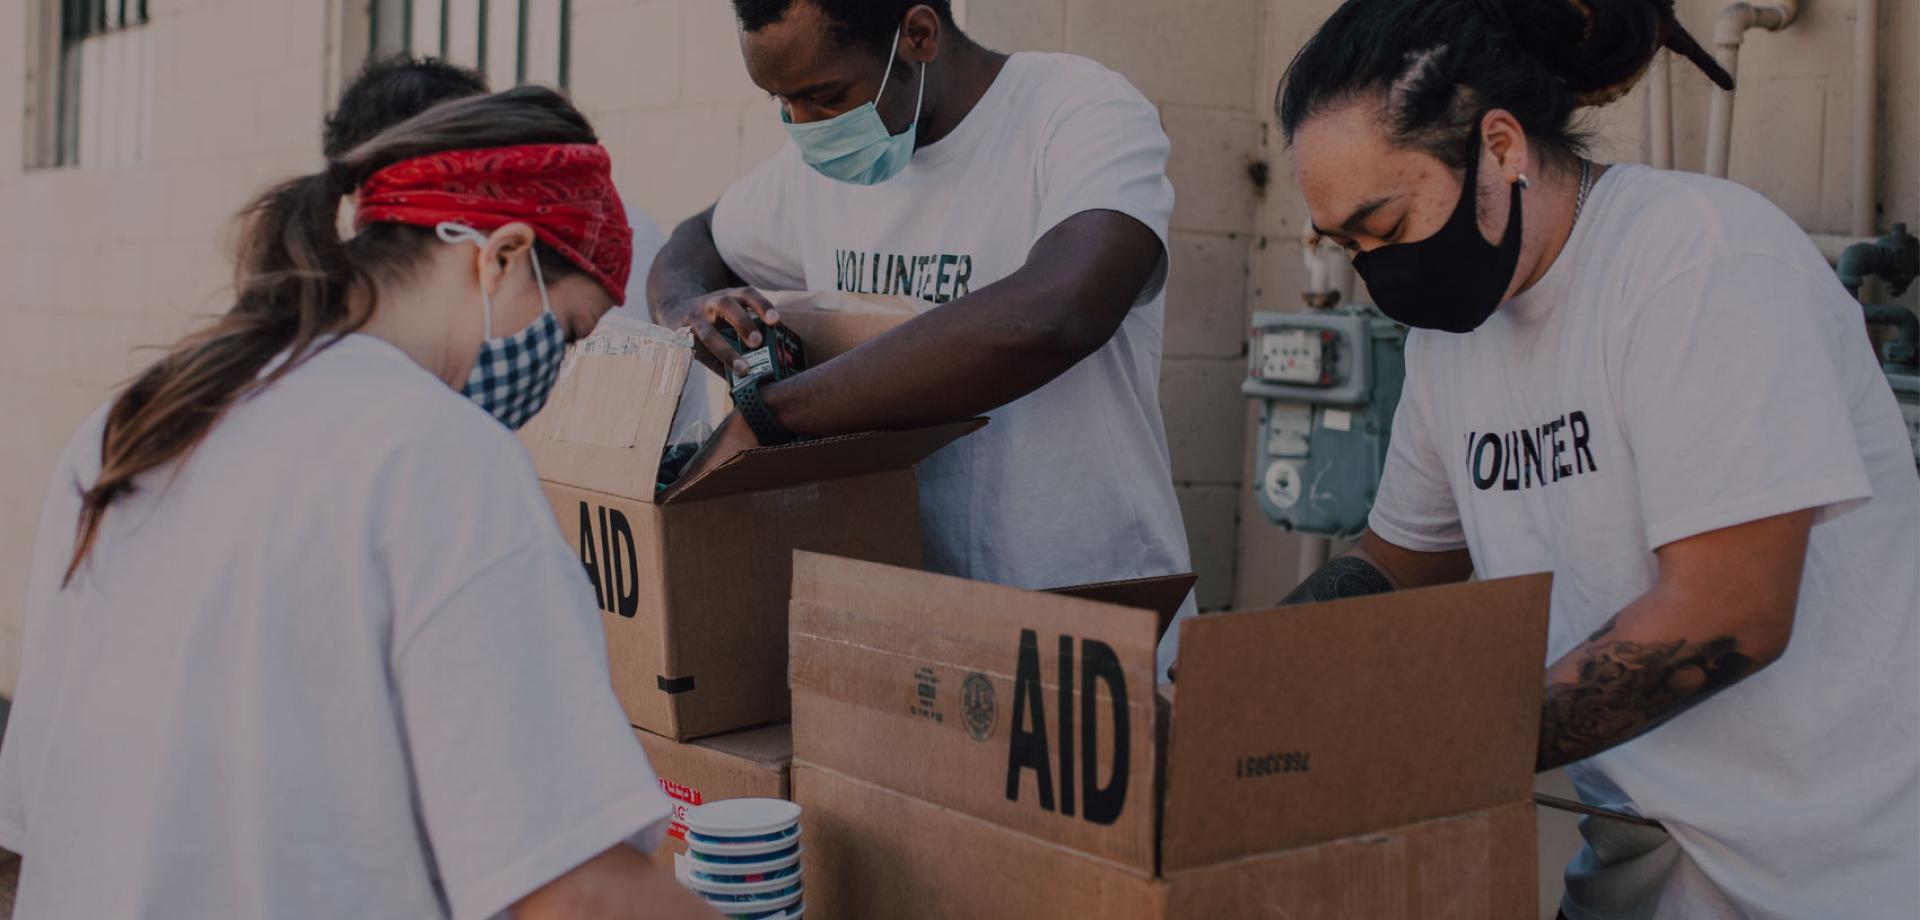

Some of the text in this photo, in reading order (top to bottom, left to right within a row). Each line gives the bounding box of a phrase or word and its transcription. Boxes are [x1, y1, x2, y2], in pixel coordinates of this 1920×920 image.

[836, 249, 973, 303] VOLUNTEER
[1464, 411, 1597, 491] VOLUNTER
[579, 501, 639, 618] AID
[1006, 628, 1131, 826] AID
